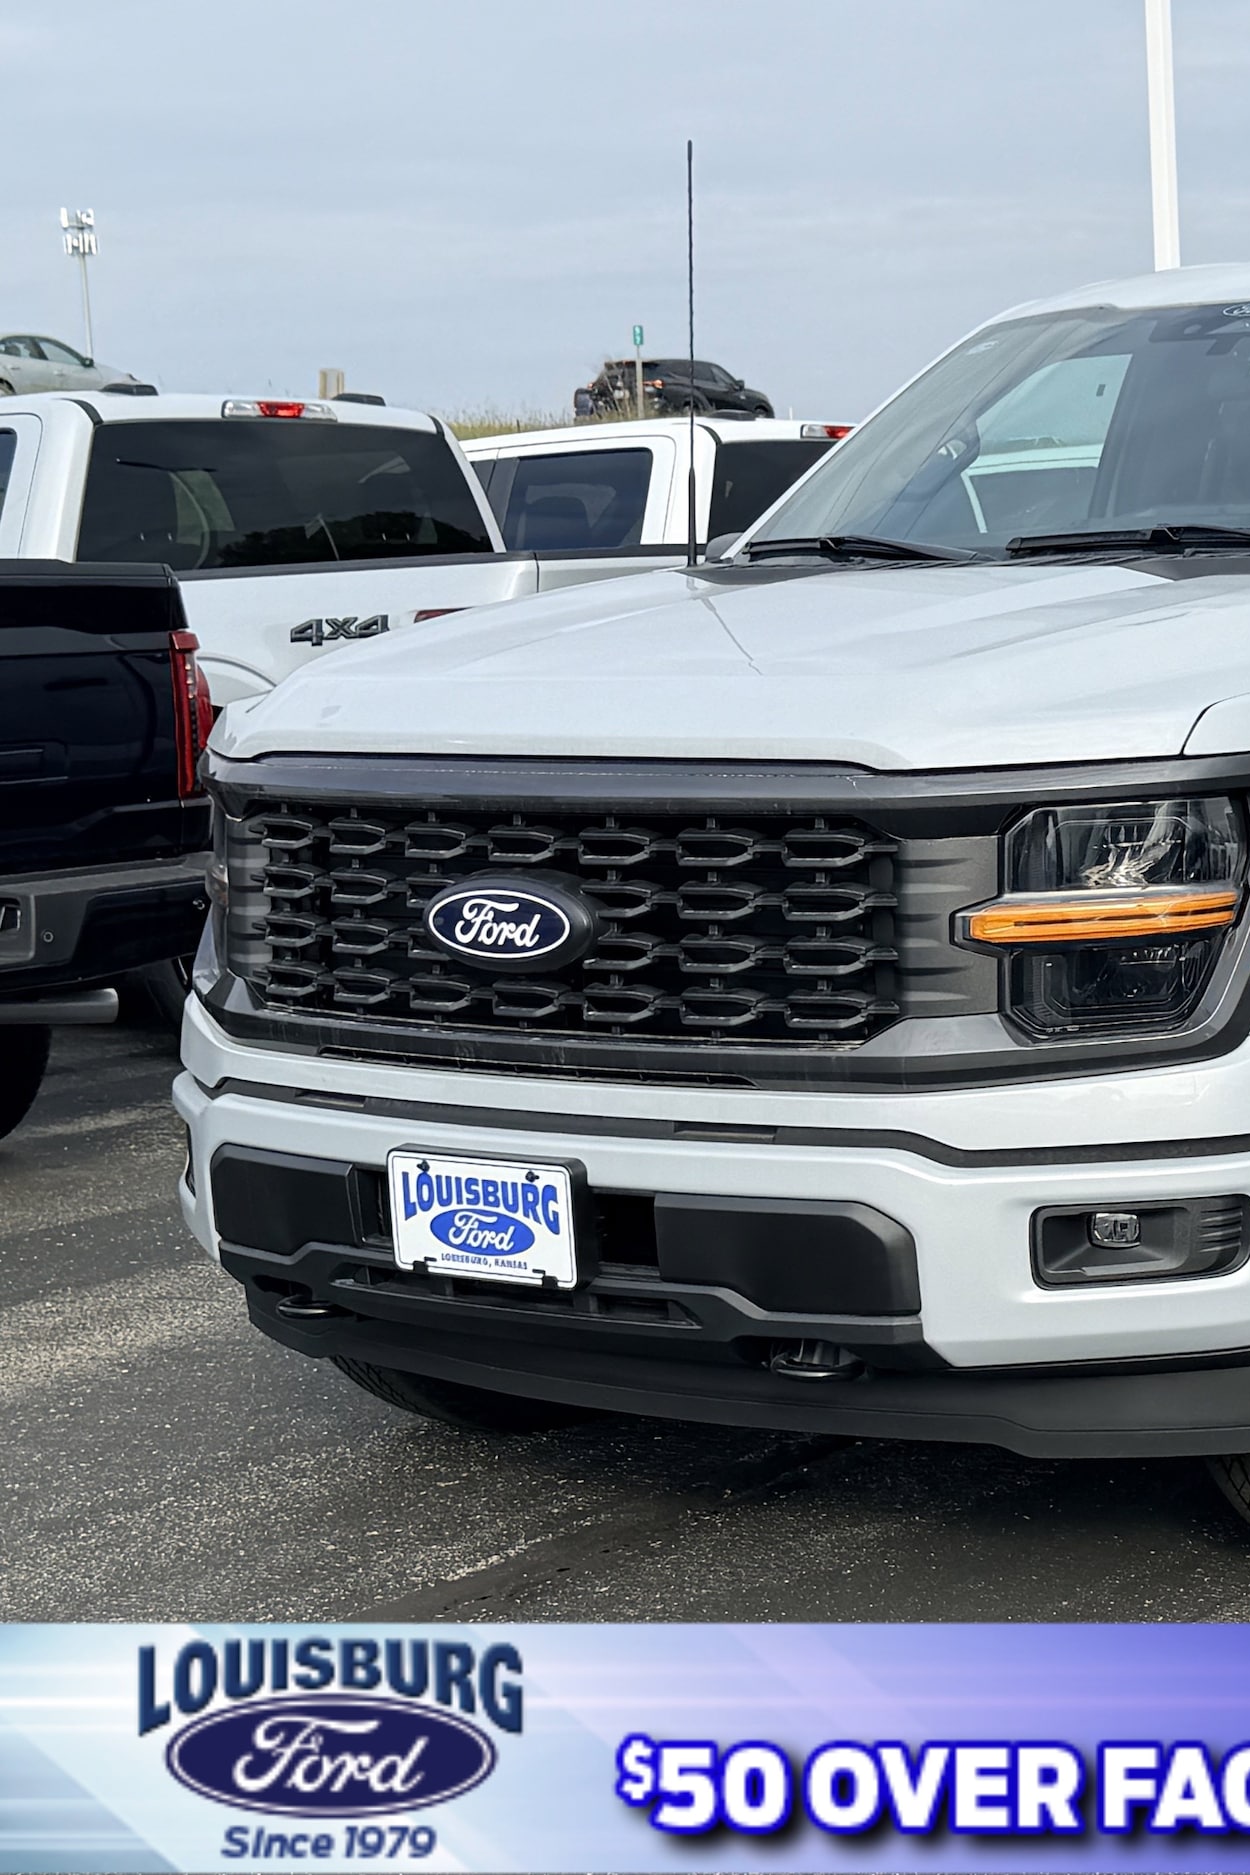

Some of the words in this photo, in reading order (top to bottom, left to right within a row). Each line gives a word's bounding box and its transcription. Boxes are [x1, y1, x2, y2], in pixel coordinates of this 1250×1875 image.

[455, 898, 541, 947] Ford
[402, 1171, 561, 1235] LOUISBURG
[448, 1211, 515, 1251] Ford
